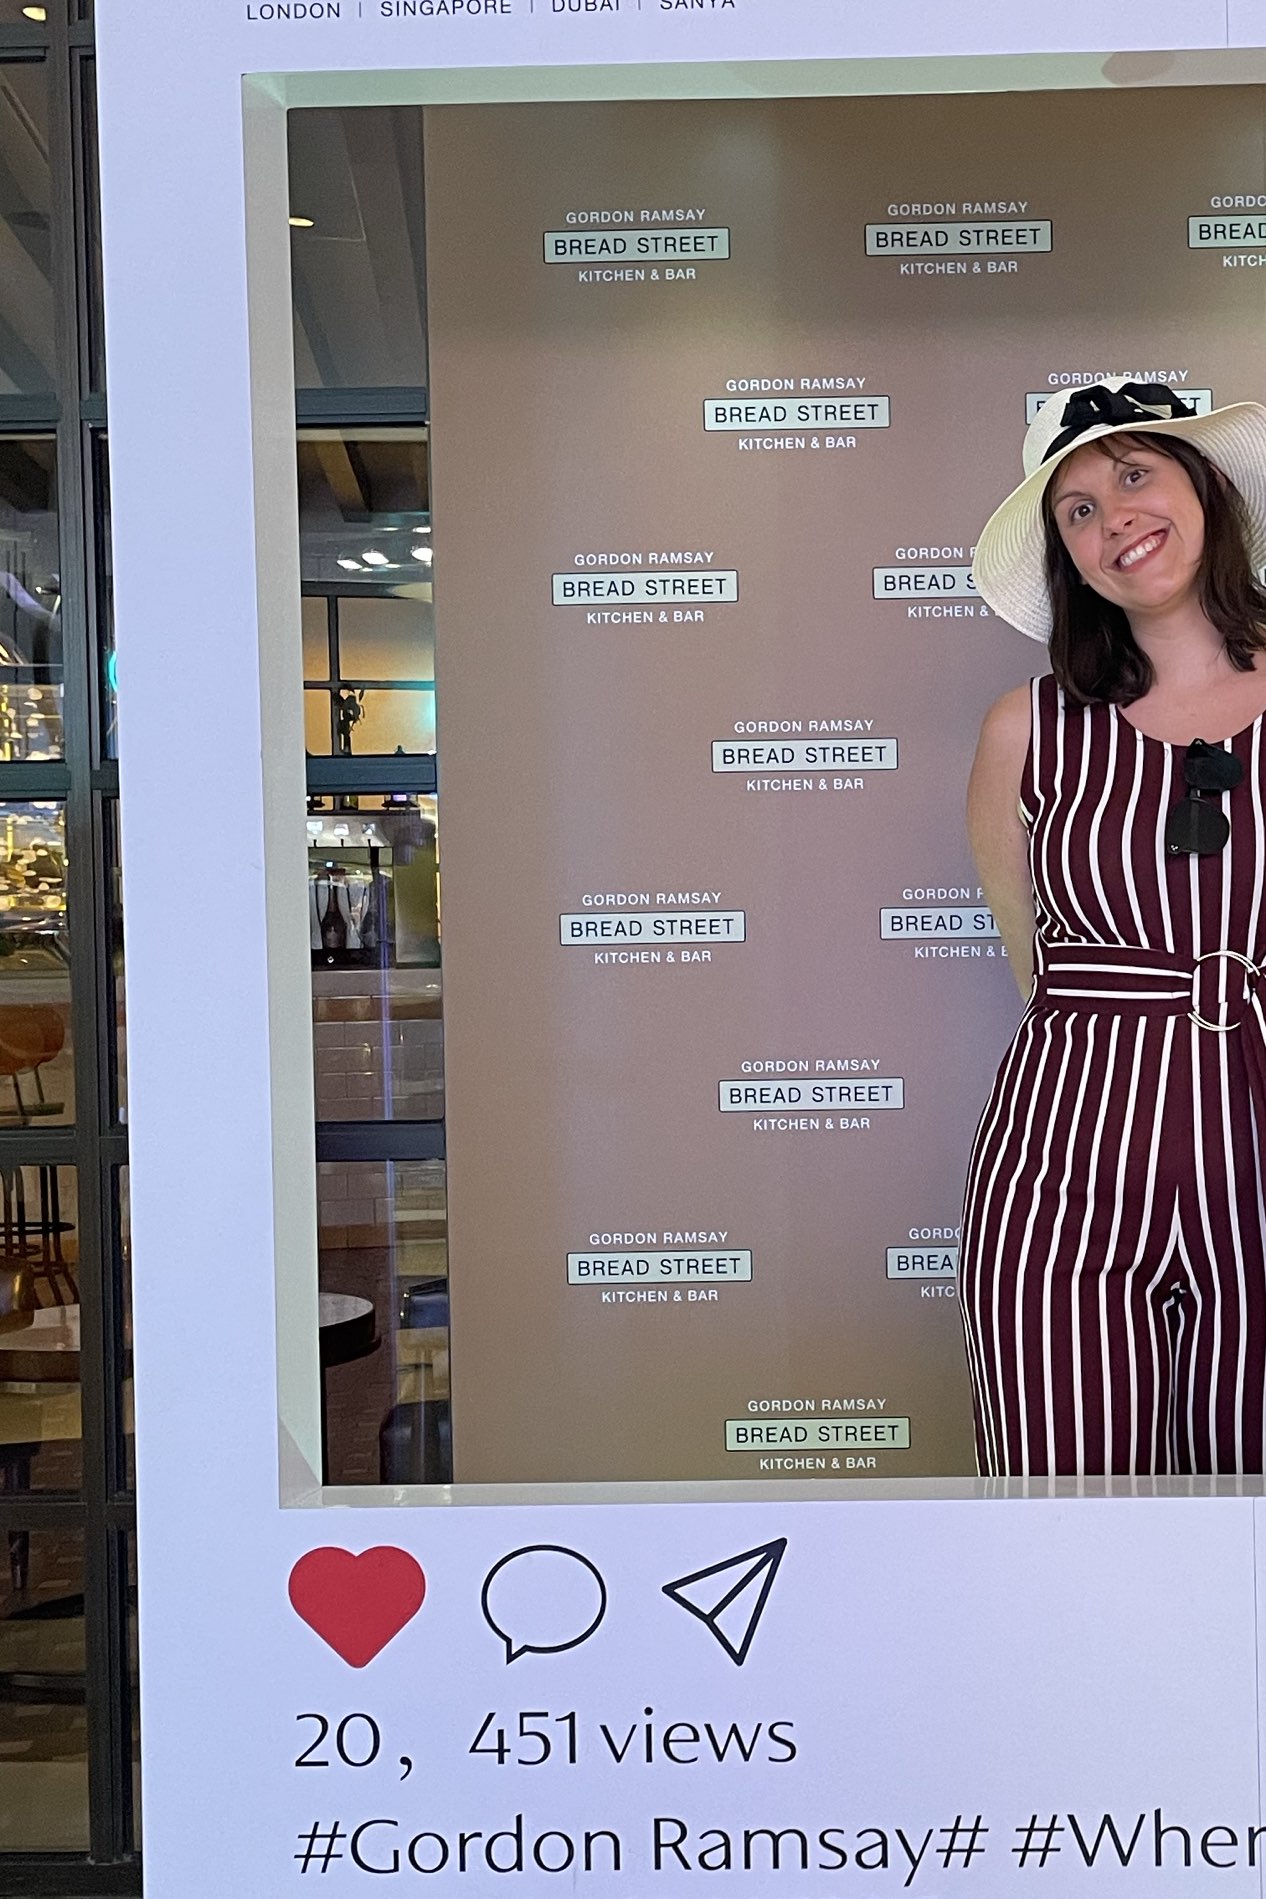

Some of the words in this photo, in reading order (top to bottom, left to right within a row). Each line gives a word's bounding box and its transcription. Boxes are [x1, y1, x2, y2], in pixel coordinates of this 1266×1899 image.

[246, 3, 341, 20] LONDON
[380, 0, 512, 17] SINGAPORE
[552, 0, 620, 13] DUBAI
[565, 210, 634, 224] GORDON
[640, 208, 706, 222] RAMSAY
[887, 203, 956, 216] GORDON
[962, 201, 1028, 214] RAMSAY
[554, 238, 627, 256] BREAD
[637, 235, 719, 254] STREET
[876, 230, 949, 248] BREAD
[959, 228, 1041, 247] STREET
[578, 269, 645, 282] KITCHEN
[650, 268, 660, 281] &
[665, 268, 696, 281] BAR
[900, 262, 967, 275] KITCHEN
[972, 261, 981, 274] &
[987, 260, 1018, 273] BAR
[725, 378, 794, 392] GORDON
[800, 377, 866, 390] RAMSAY
[715, 405, 787, 423] BREAD
[797, 403, 879, 422] STREET
[738, 437, 805, 451] KITCHEN
[810, 436, 820, 449] &
[825, 436, 856, 449] BAR
[574, 552, 642, 566] GORDON
[648, 551, 714, 565] RAMSAY
[895, 547, 963, 560] GORDON
[563, 580, 635, 598] BREAD
[645, 578, 727, 596] STREET
[884, 573, 956, 591] BREAD
[587, 611, 653, 624] KITCHEN
[658, 610, 669, 623] &
[673, 610, 704, 623] BAR
[907, 605, 974, 618] KITCHEN
[979, 605, 989, 617] &
[734, 720, 802, 734] GORDON
[808, 719, 874, 732] RAMSAY
[722, 747, 795, 765] BREAD
[805, 745, 887, 764] STREET
[746, 778, 813, 791] KITCHEN
[818, 778, 828, 791] &
[833, 777, 864, 790] BAR
[582, 893, 650, 906] GORDON
[656, 892, 722, 905] RAMSAY
[902, 887, 970, 900] GORDON
[570, 920, 643, 938] BREAD
[653, 918, 734, 936] STREET
[891, 914, 963, 931] BREAD
[594, 951, 661, 964] KITCHEN
[666, 951, 676, 963] &
[681, 950, 712, 962] BAR
[914, 945, 981, 958] KITCHEN
[986, 945, 996, 957] &
[741, 1060, 809, 1073] GORDON
[815, 1059, 880, 1072] RAMSAY
[729, 1087, 802, 1104] BREAD
[811, 1085, 893, 1103] STREET
[753, 1118, 820, 1131] KITCHEN
[824, 1117, 834, 1130] &
[839, 1117, 870, 1130] BAR
[589, 1232, 657, 1246] GORDON
[663, 1231, 728, 1244] RAMSAY
[578, 1259, 650, 1277] BREAD
[660, 1257, 741, 1275] STREET
[897, 1254, 954, 1271] BREA
[601, 1290, 668, 1303] KITCHEN
[673, 1290, 682, 1302] &
[687, 1289, 718, 1302] BAR
[920, 1285, 956, 1298] KITC
[747, 1399, 815, 1412] GORDON
[821, 1398, 886, 1411] RAMSAY
[736, 1426, 808, 1444] BREAD
[818, 1424, 899, 1443] STREET
[759, 1457, 826, 1470] KITCHEN
[830, 1457, 841, 1469] &
[846, 1456, 876, 1469] BAR
[468, 1711, 577, 1766] 451
[599, 1706, 797, 1764] views
[293, 1813, 621, 1874] #Gordon
[653, 1814, 990, 1888] Ramsay#
